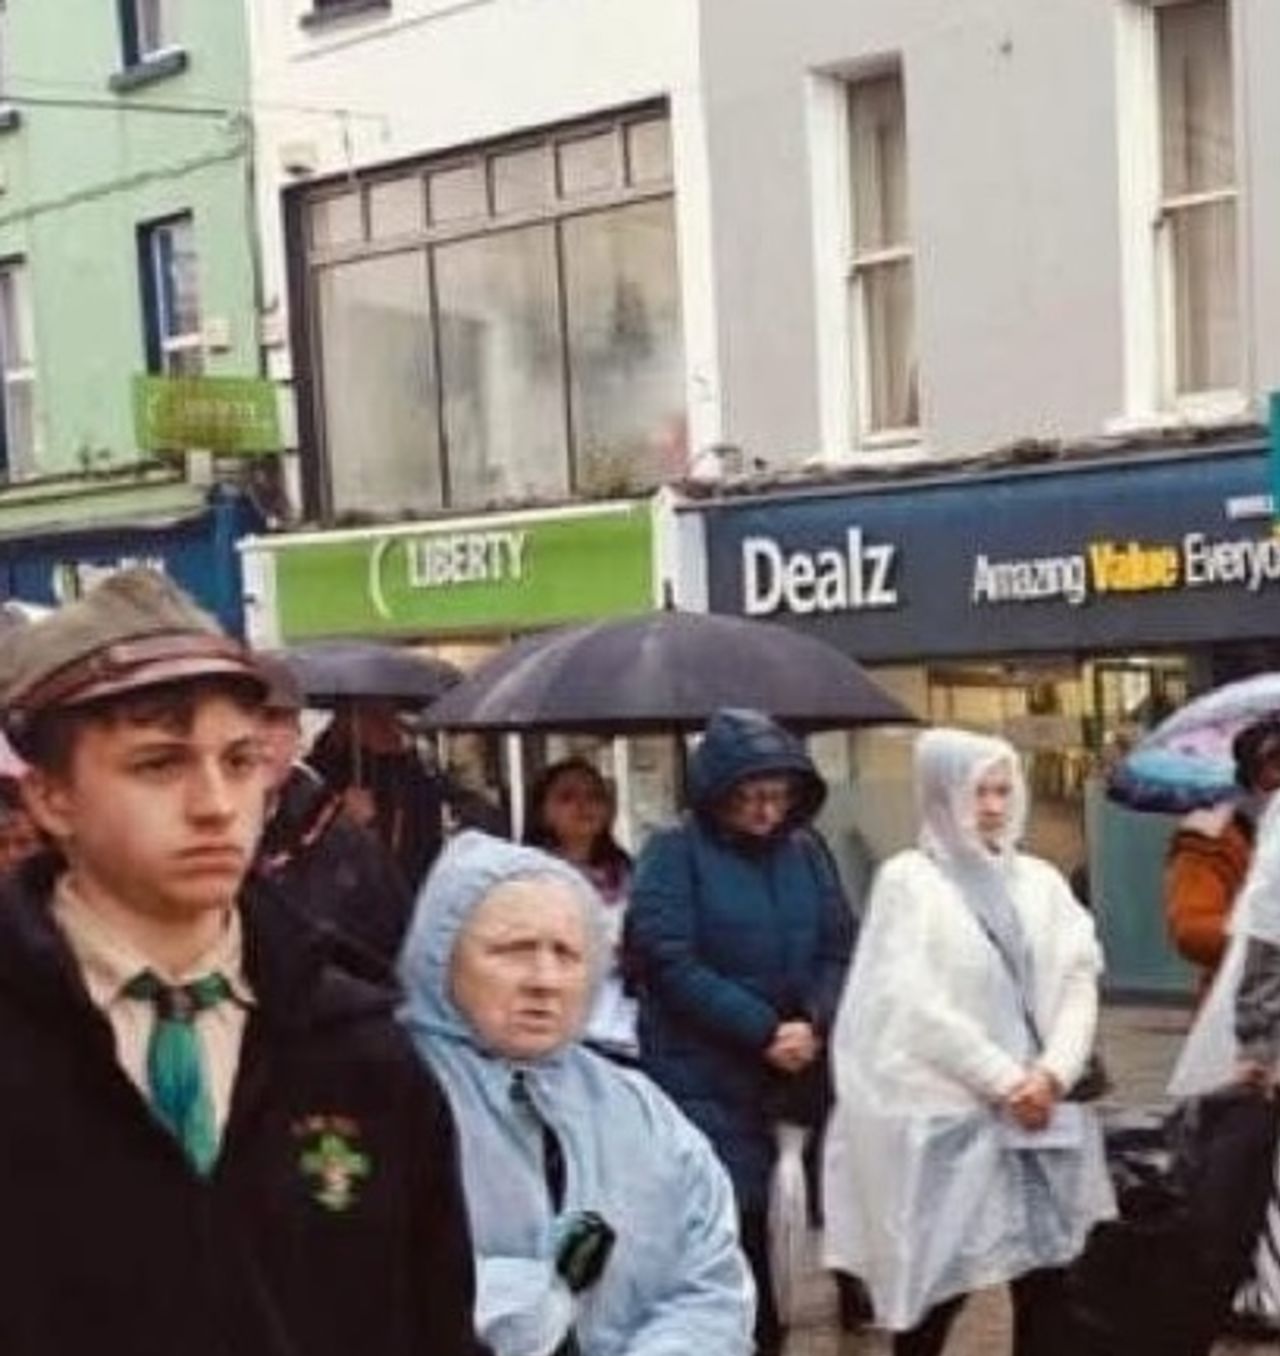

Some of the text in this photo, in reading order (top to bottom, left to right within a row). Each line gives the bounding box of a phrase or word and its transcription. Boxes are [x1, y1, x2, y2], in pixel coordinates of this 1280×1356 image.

[407, 532, 526, 587] LIBERTY
[742, 526, 898, 616] Dealz
[974, 553, 1087, 604] Amazing
[1090, 541, 1179, 592] Value
